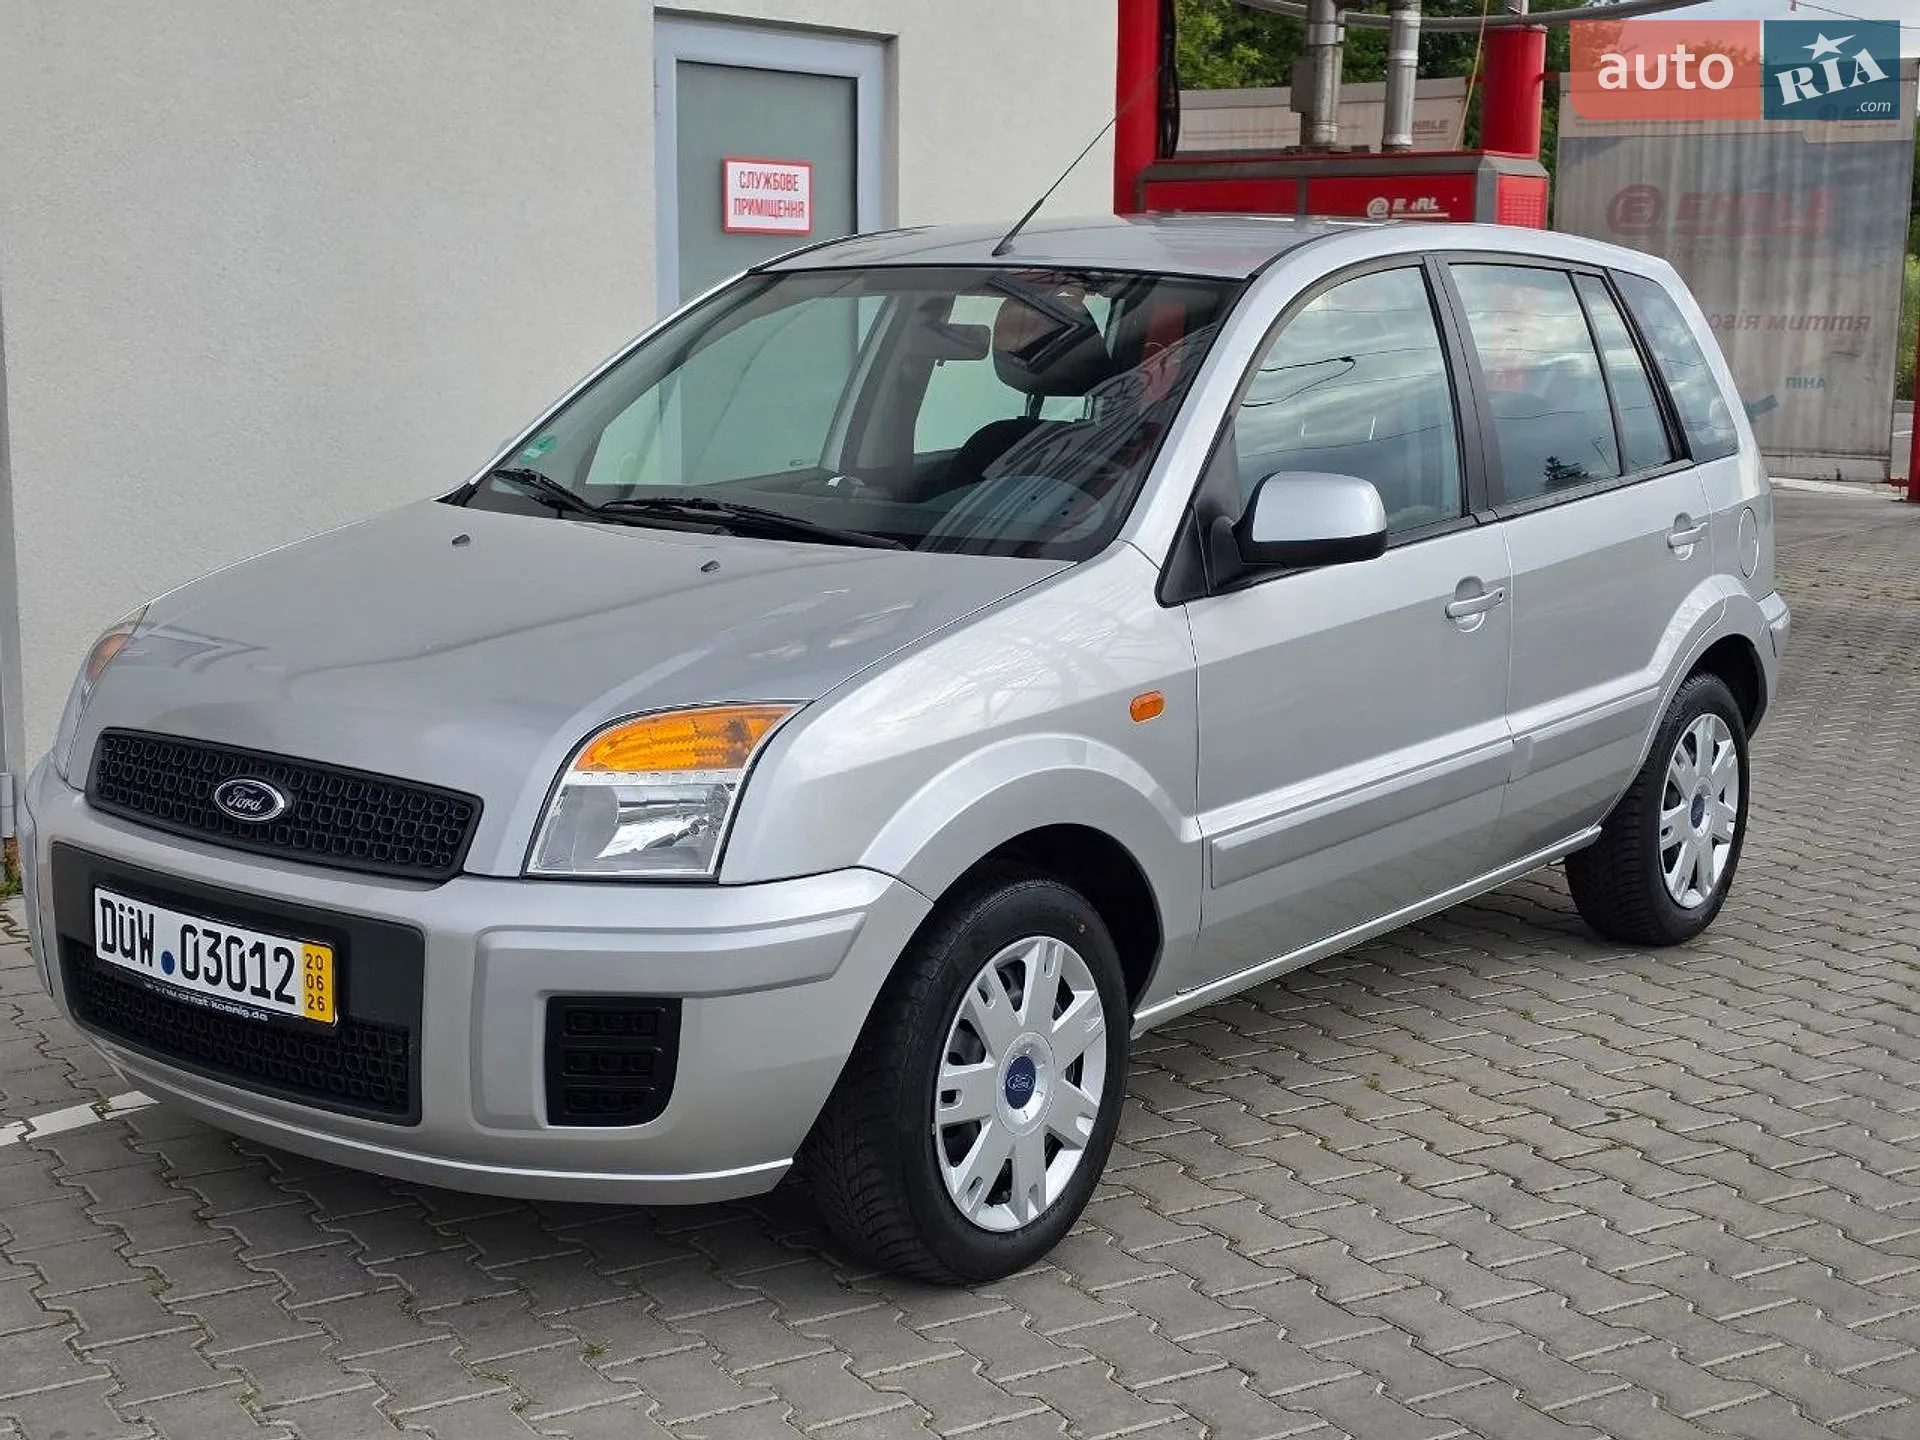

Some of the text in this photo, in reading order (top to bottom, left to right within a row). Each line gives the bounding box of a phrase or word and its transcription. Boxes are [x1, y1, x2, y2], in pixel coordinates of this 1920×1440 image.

[739, 171, 799, 191] СЛУЖБОВЕ
[733, 198, 804, 219] ПРИМІЩЕННЯ
[227, 786, 266, 811] Ford
[180, 924, 296, 1005] 03012
[305, 953, 324, 971] 20
[305, 974, 324, 991] 06
[307, 994, 325, 1011] 26
